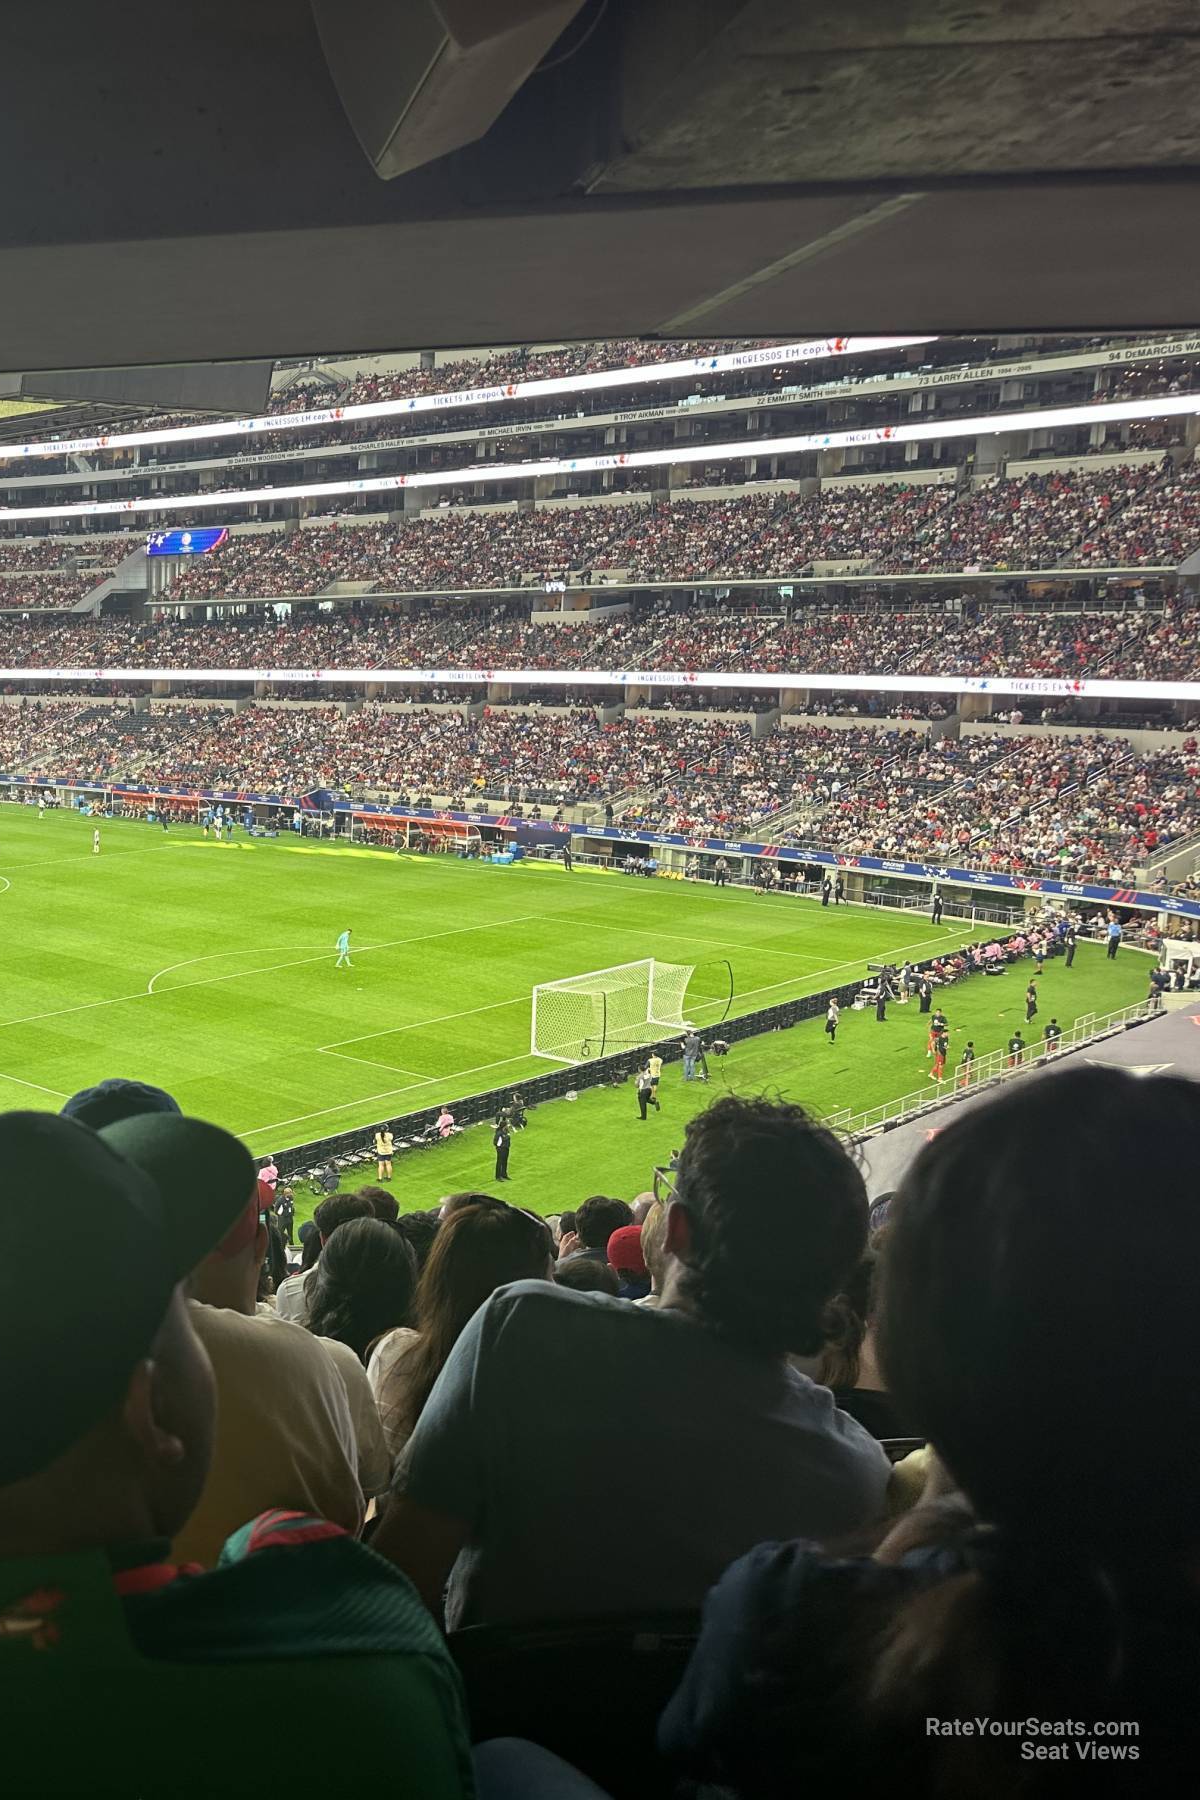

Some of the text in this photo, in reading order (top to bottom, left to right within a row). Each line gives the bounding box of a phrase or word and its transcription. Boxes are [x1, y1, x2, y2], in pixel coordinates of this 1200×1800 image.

[732, 350, 782, 366] INGRESSOS
[1108, 352, 1121, 361] 94
[918, 377, 930, 385] 73
[932, 373, 962, 383] LARRY
[963, 369, 994, 380] ALLEN
[433, 394, 463, 406] TICKETS
[768, 393, 797, 403] EMMITT
[799, 390, 824, 400] SMITH
[620, 413, 638, 421] TROY
[638, 410, 664, 419] AIKMAN
[488, 427, 514, 436] MICHAEL
[516, 426, 532, 434] IRVIN
